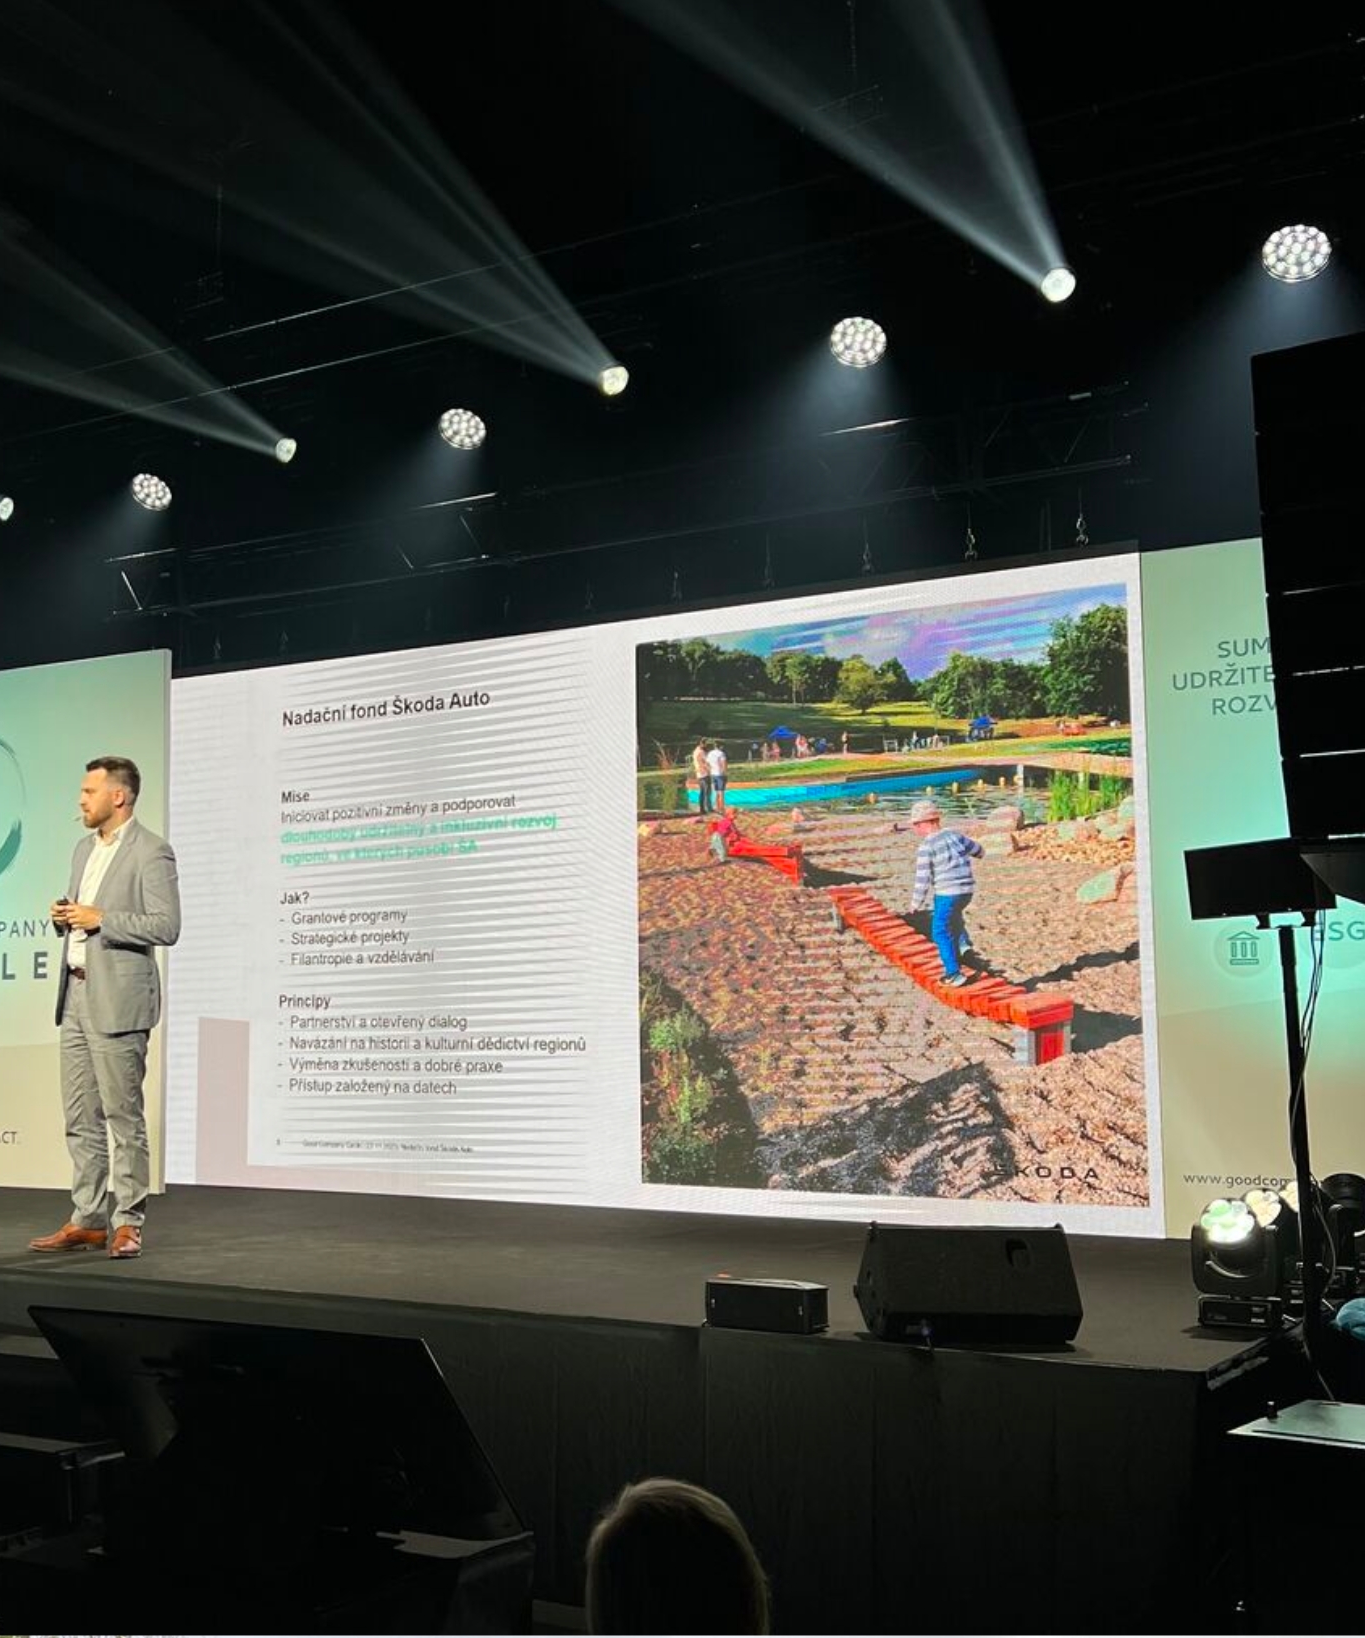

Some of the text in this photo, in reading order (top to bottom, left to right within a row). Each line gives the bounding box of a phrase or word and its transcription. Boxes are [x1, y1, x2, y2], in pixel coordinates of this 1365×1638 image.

[282, 690, 491, 726] Nadační fond Škoda Auto
[281, 790, 311, 803] Mise
[281, 810, 330, 824] Iniciovat
[385, 802, 426, 819] změny
[430, 802, 439, 813] a
[442, 795, 516, 815] podporovat
[280, 890, 310, 905] Jak?
[291, 910, 408, 925] Grantové programy
[291, 929, 410, 946] Strategické projekty
[291, 950, 435, 967] Filantropie a vzdělávání
[279, 994, 331, 1009] Principy
[290, 1014, 468, 1032] Partnerství a otevřený dialog
[289, 1036, 587, 1054] Navázání na historii a kulturní dědictví regionů
[289, 1057, 339, 1073] Výměna
[413, 1061, 422, 1072] a
[425, 1057, 463, 1072] dobré
[466, 1061, 503, 1076] praxe
[289, 1078, 457, 1096] Přístup založený na datech
